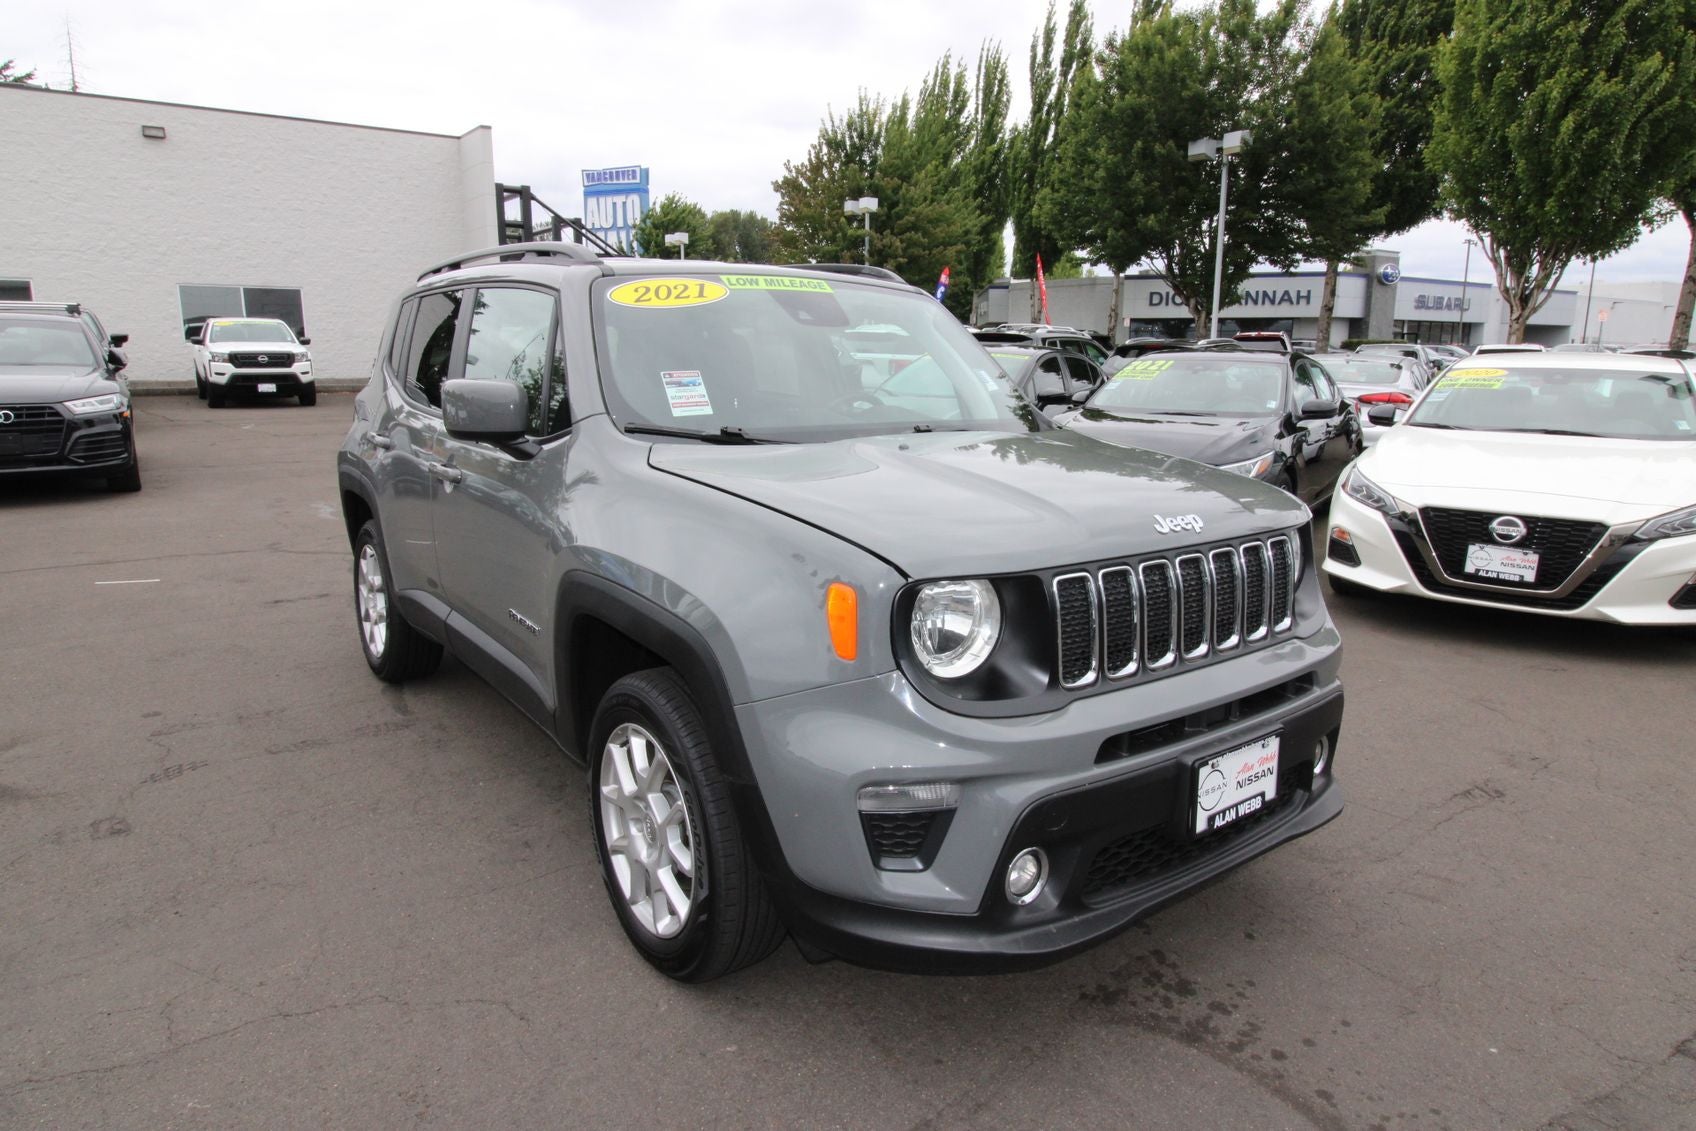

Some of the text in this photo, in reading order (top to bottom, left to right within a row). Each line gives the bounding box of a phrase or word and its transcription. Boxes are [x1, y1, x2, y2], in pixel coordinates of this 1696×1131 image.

[586, 193, 641, 229] AUTO
[633, 282, 708, 303] 2021
[726, 277, 827, 290] LOW MILEAGE
[1149, 289, 1312, 307] DIC NNAH
[1414, 294, 1471, 312] SUBARU
[1123, 360, 1175, 370] 2021
[1153, 513, 1204, 534] Jeep
[1500, 561, 1536, 571] NISSAN
[1478, 570, 1520, 582] ALAN WEBB
[1235, 766, 1275, 791] NISSAN
[1213, 796, 1262, 829] ALAN WEBB
